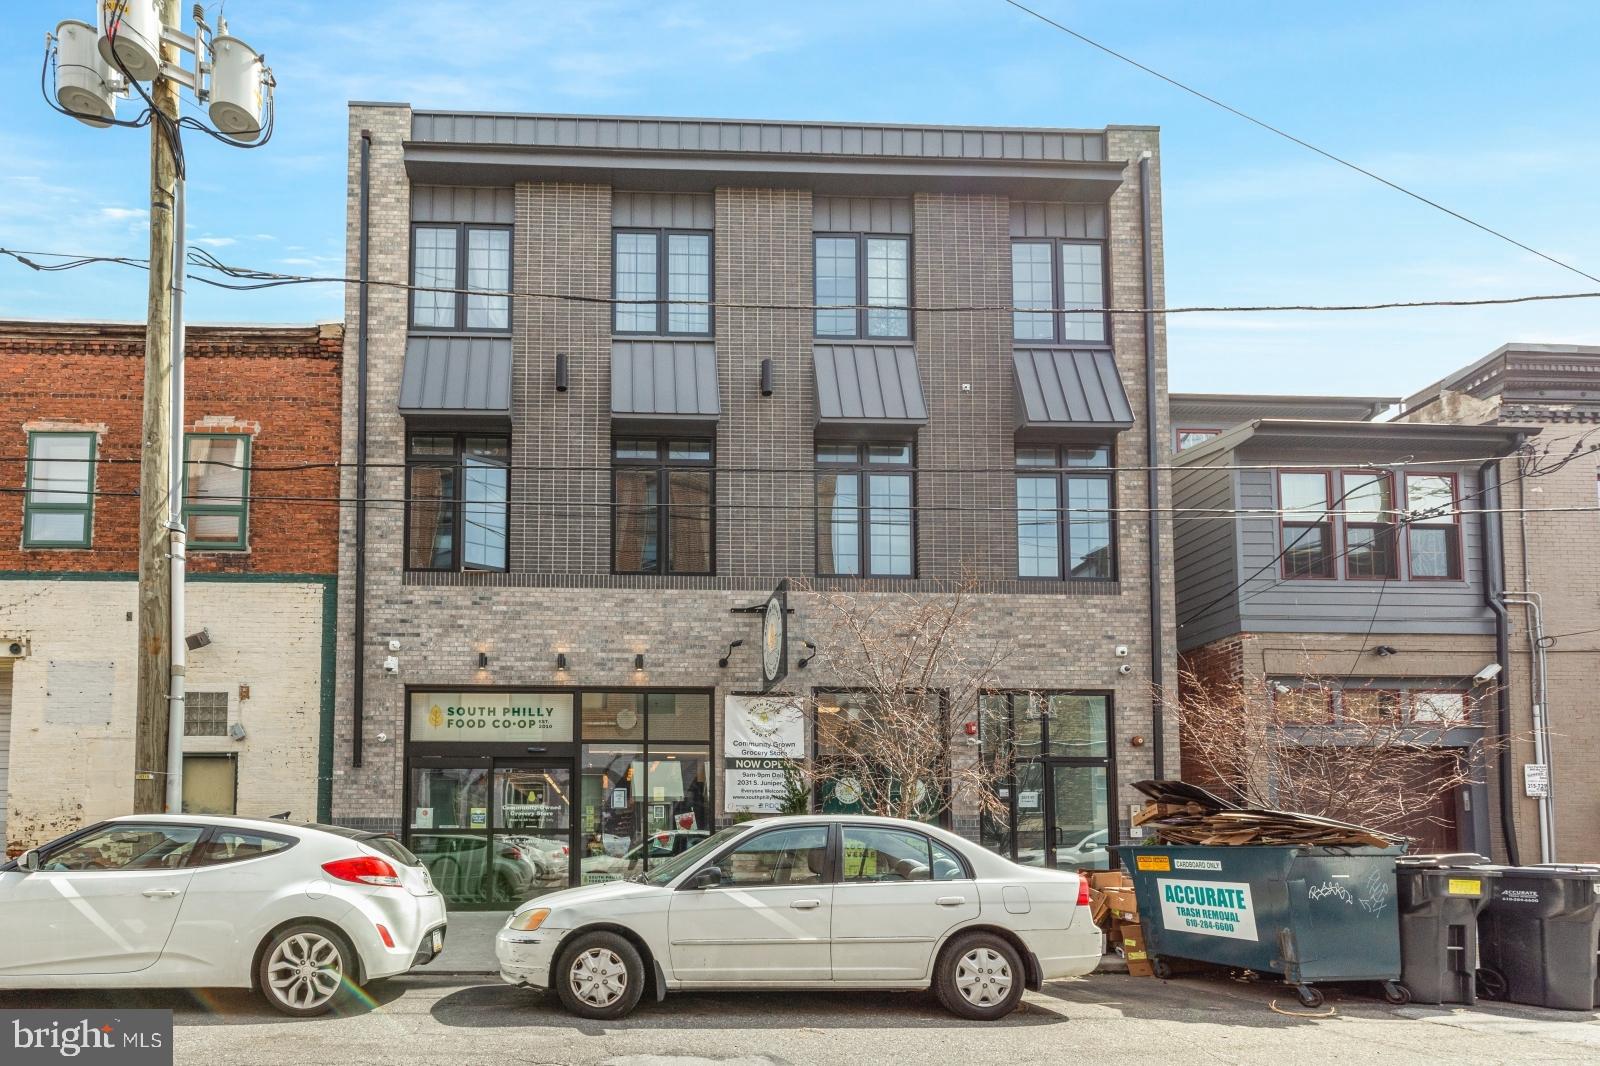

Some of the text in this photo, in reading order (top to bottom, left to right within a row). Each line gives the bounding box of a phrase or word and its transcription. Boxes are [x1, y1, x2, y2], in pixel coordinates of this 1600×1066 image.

[447, 706, 554, 717] SOUTH PHILLY
[447, 719, 486, 729] FOOD
[741, 749, 768, 758] Grocery
[735, 759, 790, 769] NOW OPE
[1176, 860, 1206, 869] CARDBOARD
[1206, 861, 1220, 869] ONLY
[1165, 884, 1247, 910] ACCURATE
[1176, 906, 1240, 923] TRASH REMOVAL
[1185, 918, 1235, 933] 610-284-6600
